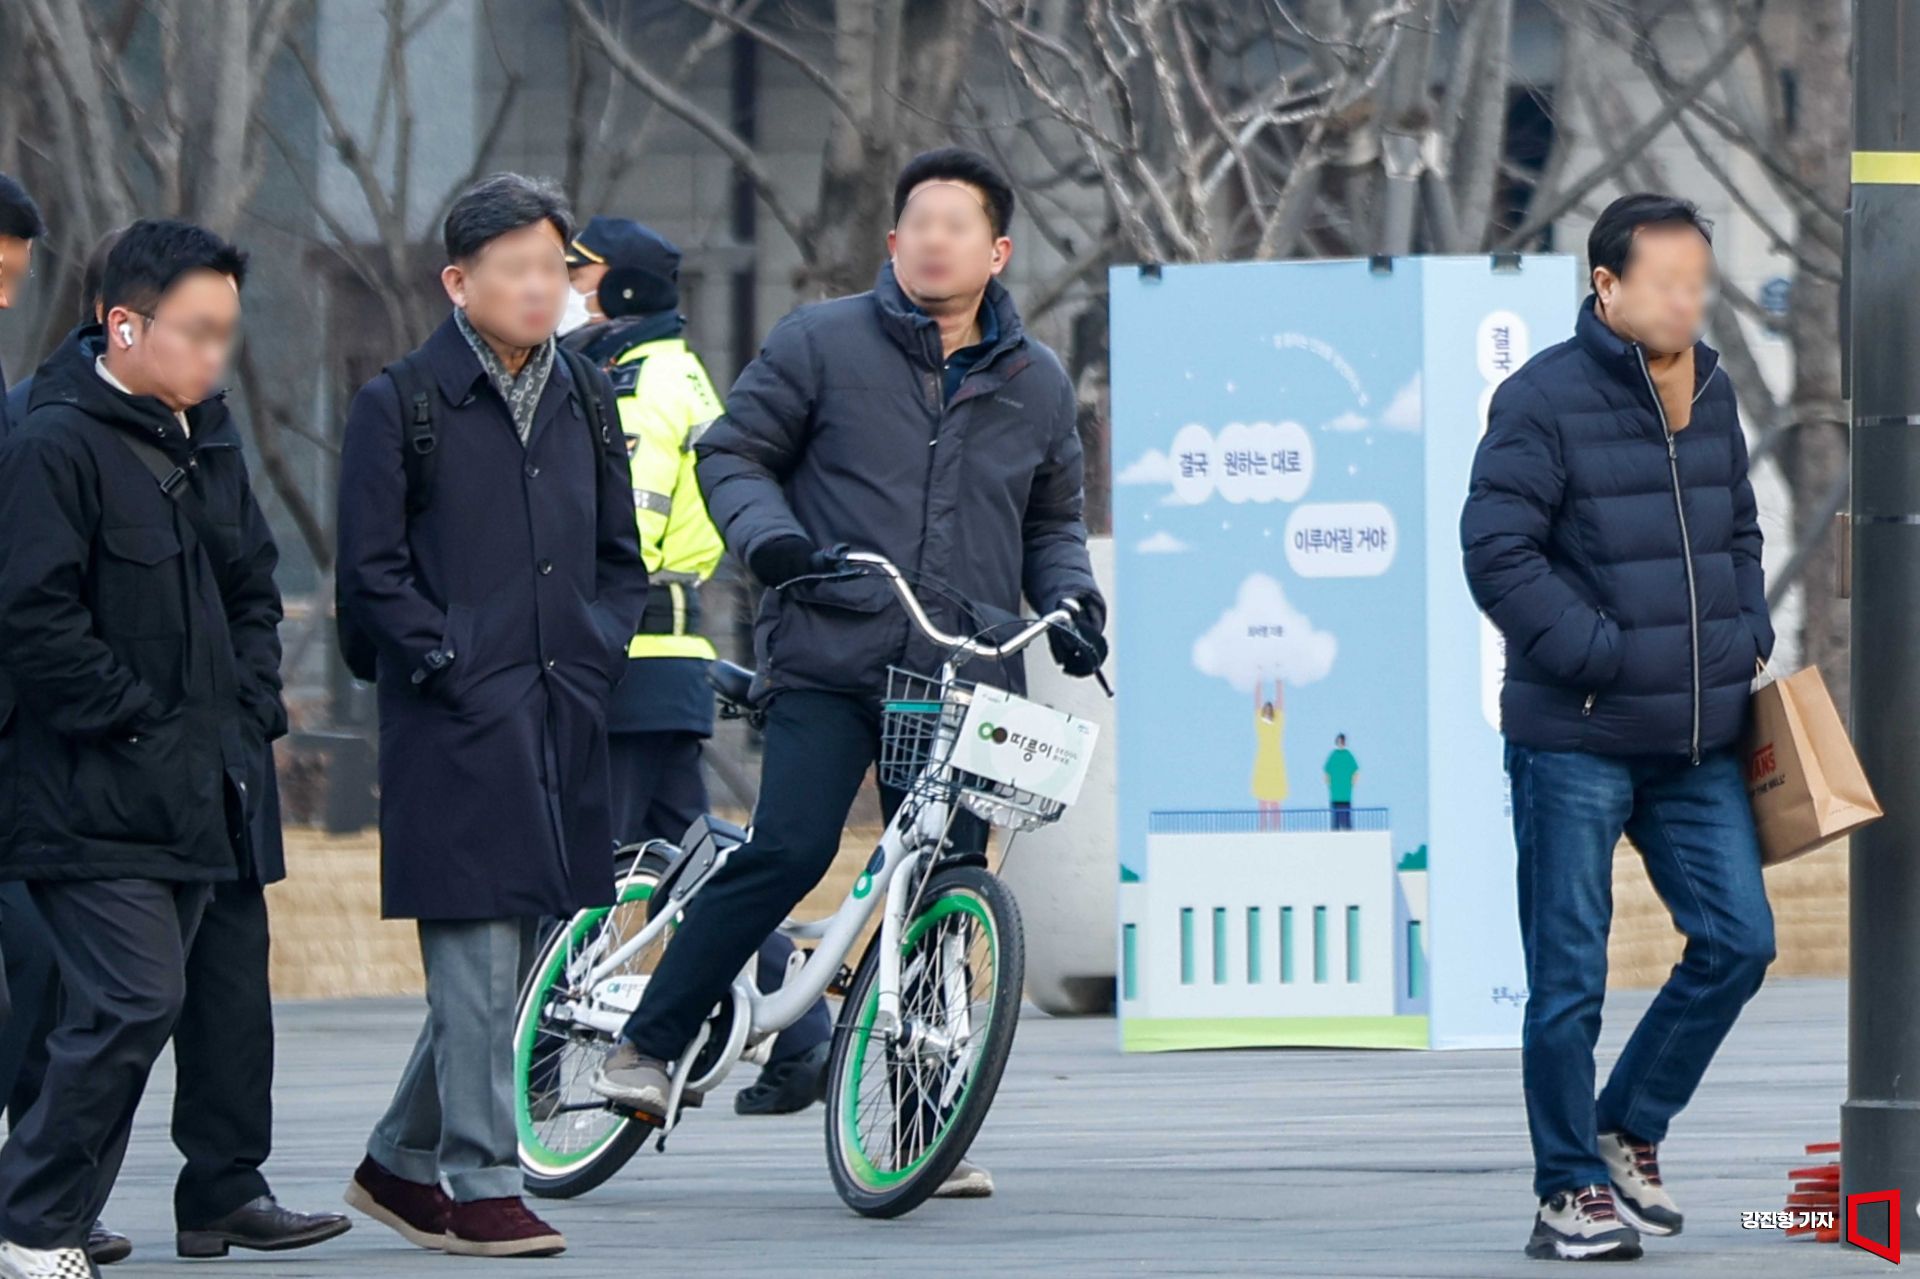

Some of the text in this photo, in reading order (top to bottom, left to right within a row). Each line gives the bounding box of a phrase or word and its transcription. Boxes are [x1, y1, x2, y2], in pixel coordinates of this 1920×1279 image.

[1179, 449, 1302, 478] 결국 원하는 대로
[1294, 526, 1388, 554] 이루어질 거야
[1009, 731, 1053, 763] 따릉이
